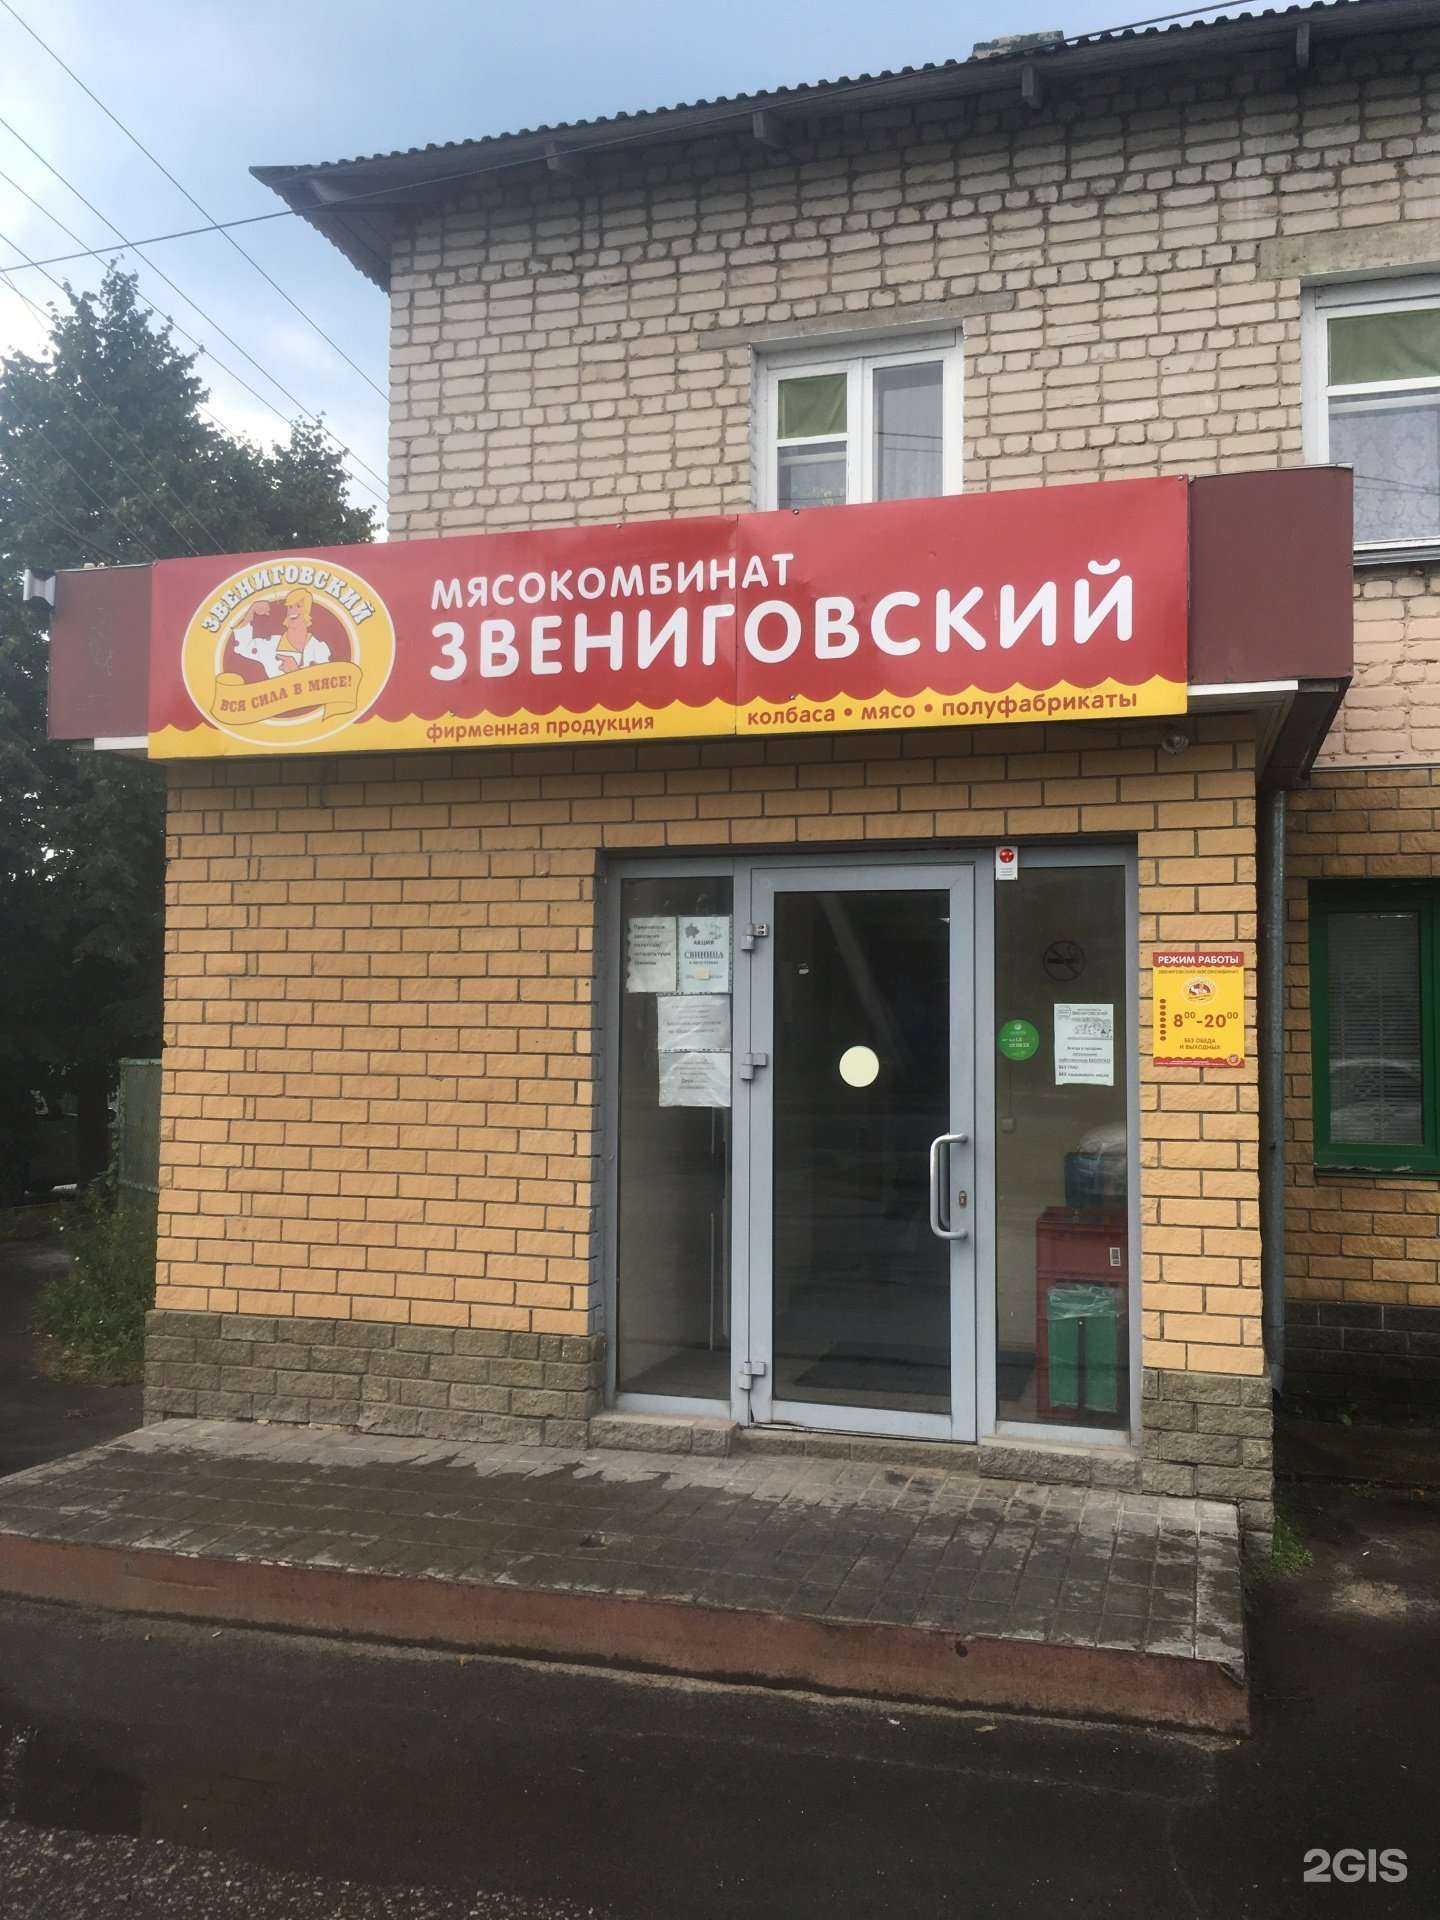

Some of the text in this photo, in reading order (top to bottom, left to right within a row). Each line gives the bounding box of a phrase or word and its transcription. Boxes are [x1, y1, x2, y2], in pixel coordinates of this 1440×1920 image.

[201, 564, 376, 634] ЗВЕНИГОВСКИЙ
[430, 552, 794, 611] МЯСОКОМБИНАТ
[429, 558, 1134, 682] ЗВЕНИГОВСКИЙ
[220, 675, 353, 712] ВСЯ СИЛА В МЯСЕ!
[426, 690, 1138, 742] фирменная продукция колбаса мясо полуфабрикаты
[1158, 955, 1239, 964] РЕЖИМ РАБОТЫ
